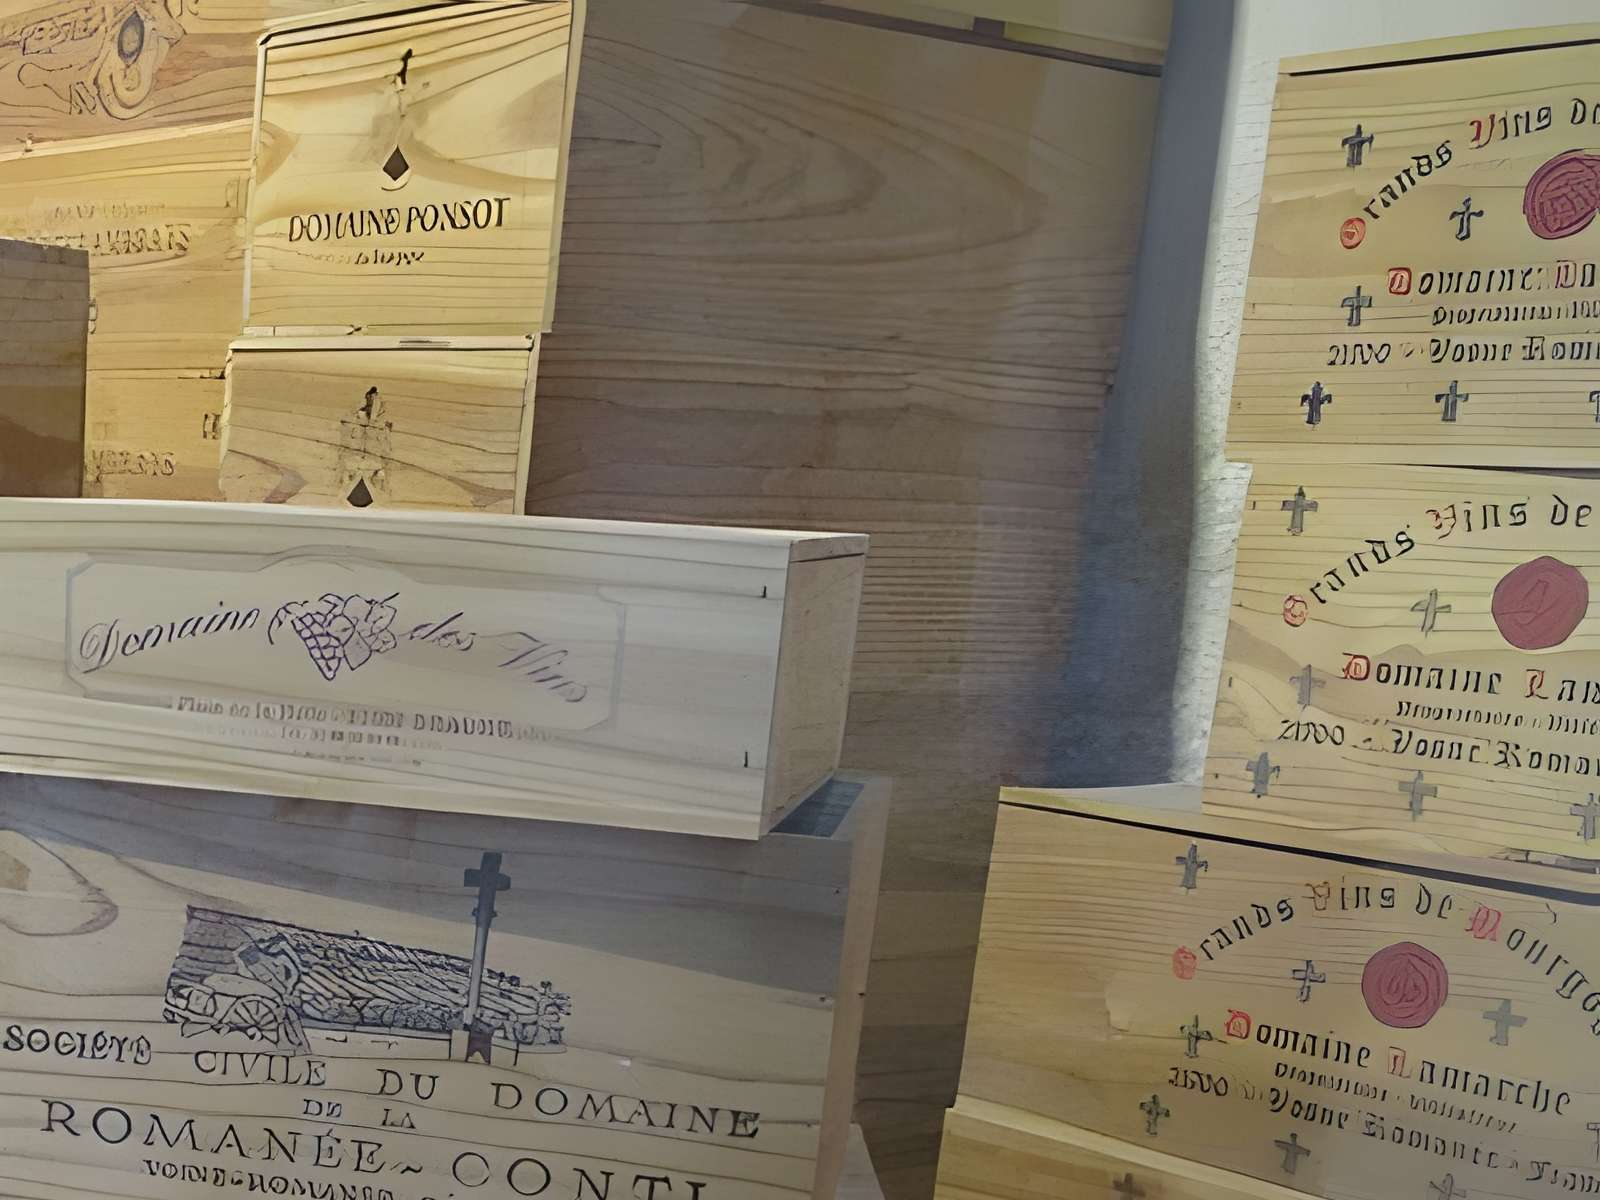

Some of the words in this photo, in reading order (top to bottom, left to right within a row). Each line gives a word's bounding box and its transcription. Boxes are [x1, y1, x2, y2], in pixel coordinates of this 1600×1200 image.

[405, 197, 512, 234] PONSOT
[1550, 493, 1593, 528] de
[377, 1066, 442, 1102] DU
[489, 1080, 762, 1141] DOMAINE
